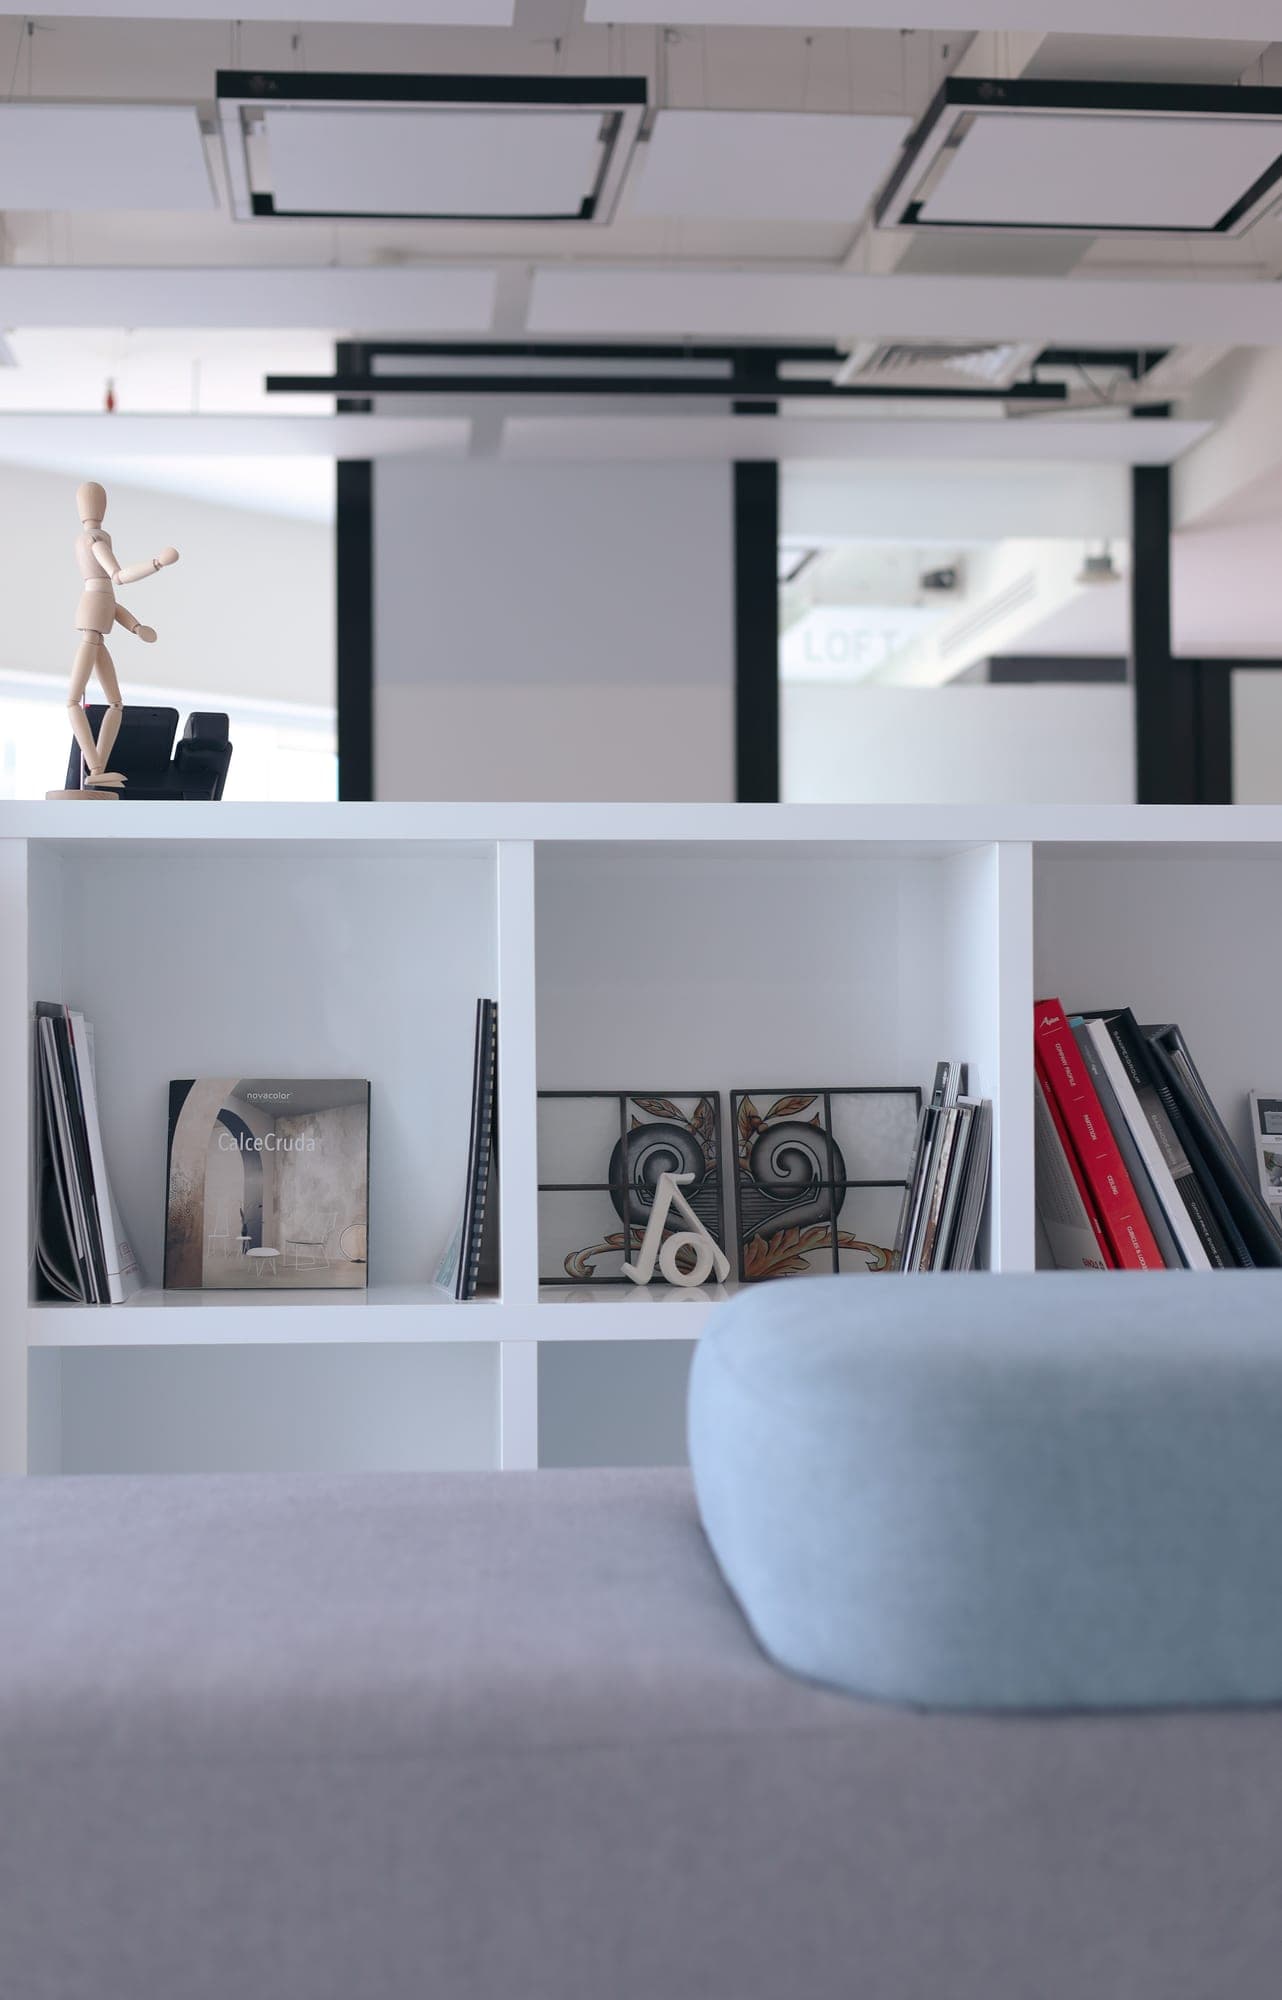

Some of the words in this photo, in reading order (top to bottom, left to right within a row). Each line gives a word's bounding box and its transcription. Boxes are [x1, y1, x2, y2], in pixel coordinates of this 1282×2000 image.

[1055, 1042, 1068, 1066] COMPANY
[1064, 1064, 1076, 1087] PROFILE
[247, 1091, 291, 1100] novacolor
[1084, 1114, 1098, 1141] PARTITION
[218, 1131, 316, 1152] CalceCruda
[1106, 1174, 1119, 1196] CEILING
